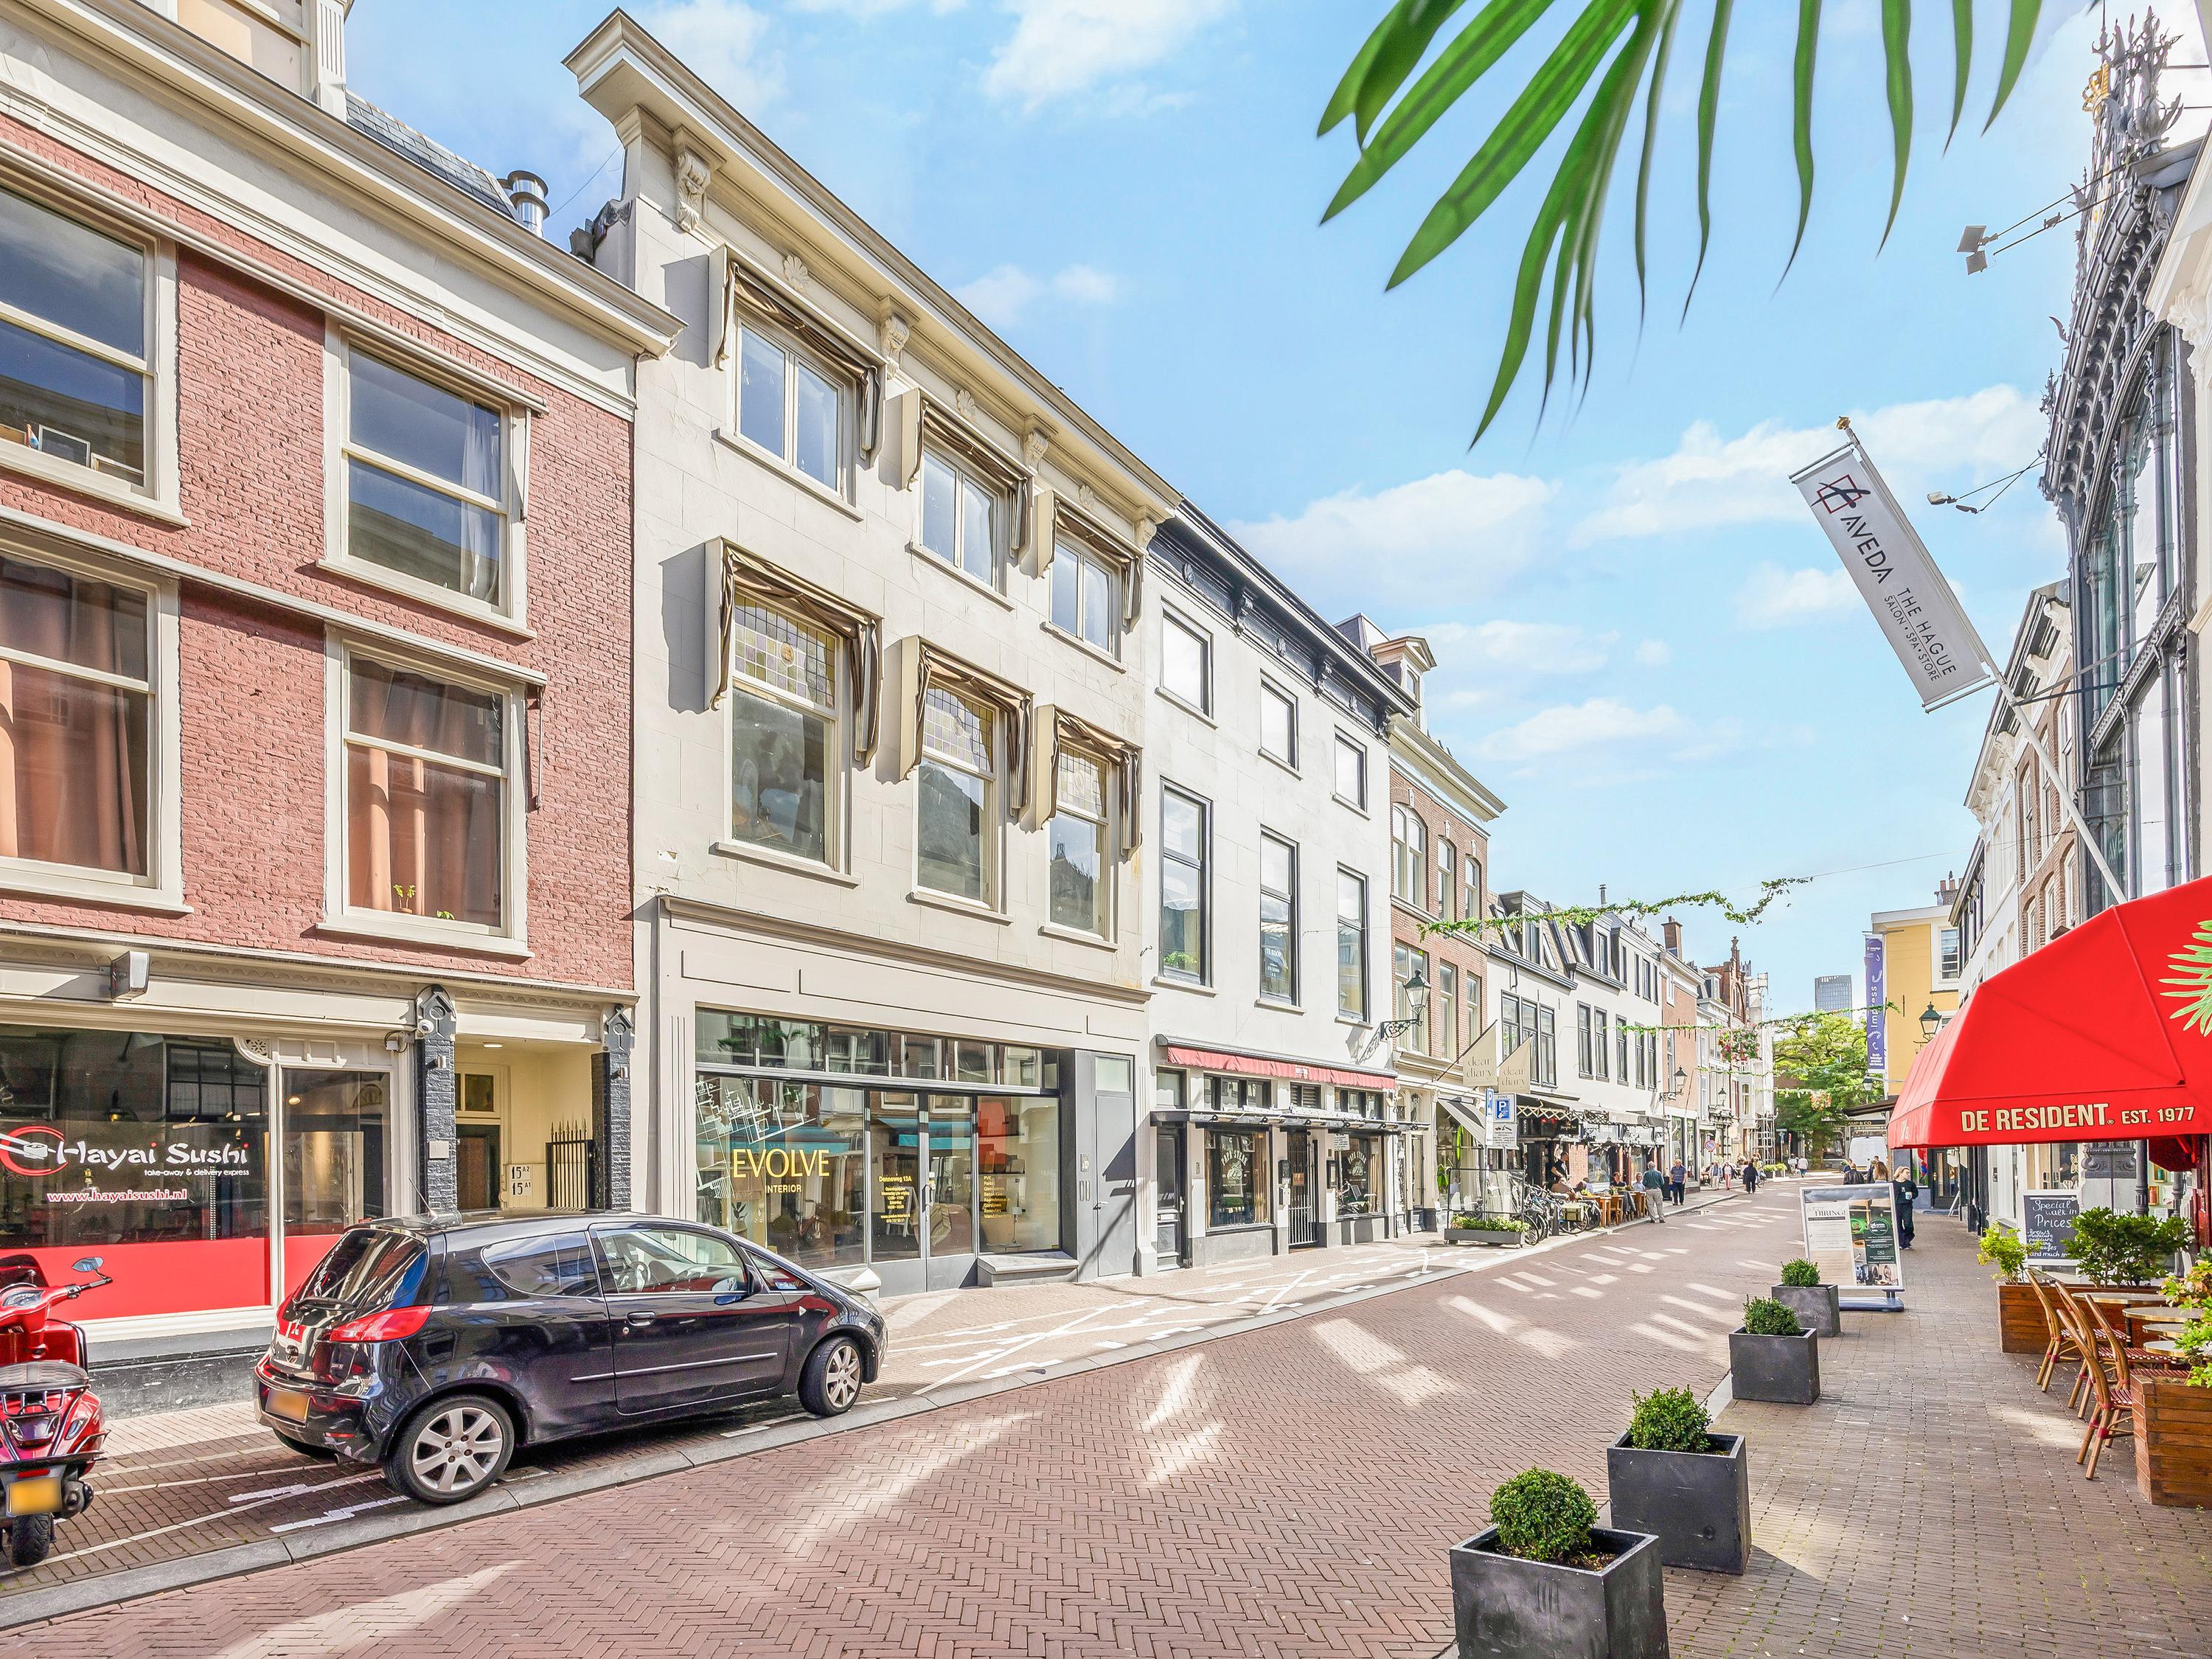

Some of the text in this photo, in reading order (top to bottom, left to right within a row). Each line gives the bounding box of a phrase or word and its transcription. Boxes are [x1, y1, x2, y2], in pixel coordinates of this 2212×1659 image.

[1840, 515, 1894, 584] AVEDA
[1897, 588, 1957, 676] THE HAGUE
[1884, 595, 1940, 682] SALON SPA STORE
[1468, 1057, 1492, 1066] dear
[1467, 1068, 1492, 1079] diary
[1503, 1066, 1526, 1076] dear
[1501, 1077, 1527, 1088] diary
[1499, 1102, 1507, 1111] P
[1961, 1110, 1990, 1133] DE
[2121, 1110, 2152, 1124] EST.
[2157, 1107, 2195, 1122] 1977
[57, 1141, 248, 1170] Hayai Sushi
[733, 1148, 830, 1178] EVOLVE
[144, 1169, 184, 1177] take-away
[194, 1169, 223, 1178] delivery
[765, 1184, 802, 1194] INTERIOR
[46, 1189, 188, 1203] www.hayaisushi.nl
[2032, 1200, 2072, 1211] Special
[2034, 1214, 2072, 1228] Prices
